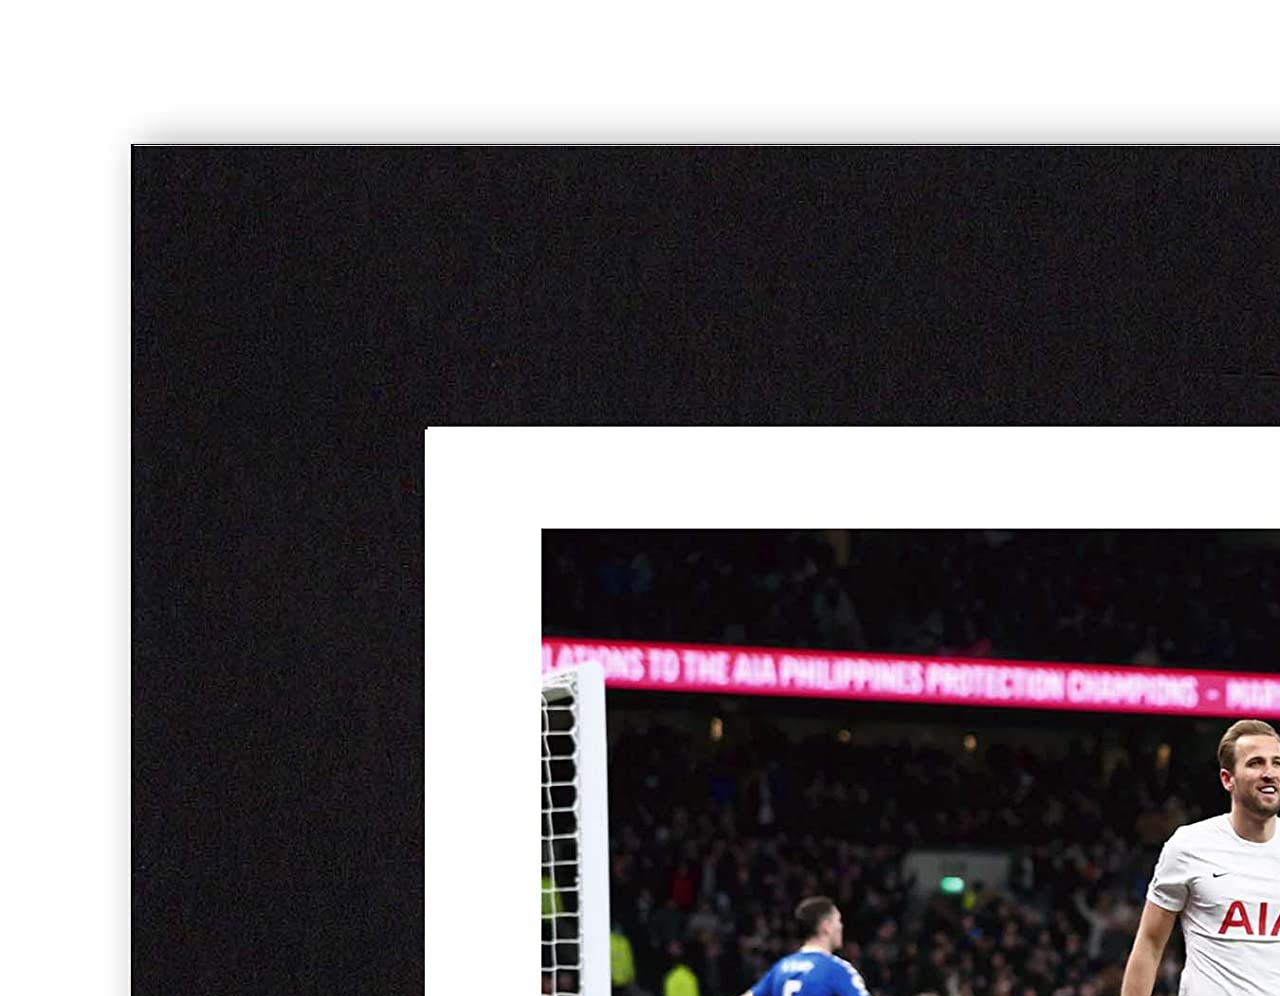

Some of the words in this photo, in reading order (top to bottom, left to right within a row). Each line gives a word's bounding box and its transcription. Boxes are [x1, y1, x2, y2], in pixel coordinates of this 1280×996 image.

[647, 648, 681, 684] TO
[683, 650, 731, 687] THE
[779, 654, 925, 695] PHILIPPINES
